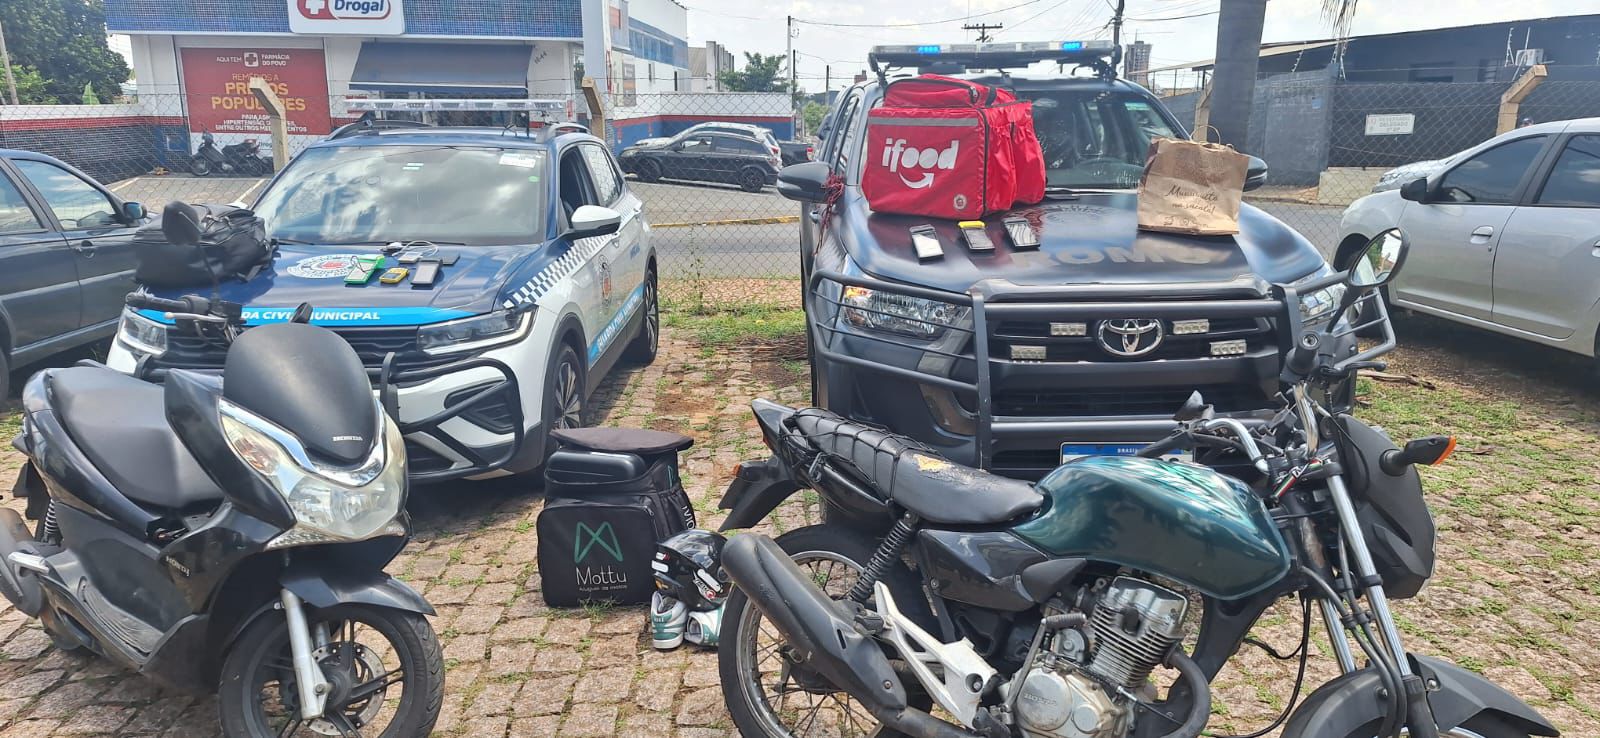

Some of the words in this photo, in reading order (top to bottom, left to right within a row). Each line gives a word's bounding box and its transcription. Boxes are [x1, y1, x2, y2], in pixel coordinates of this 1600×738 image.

[334, 0, 384, 14] Drogal
[310, 311, 381, 320] UNICIPAL
[575, 565, 627, 585] Mottu
